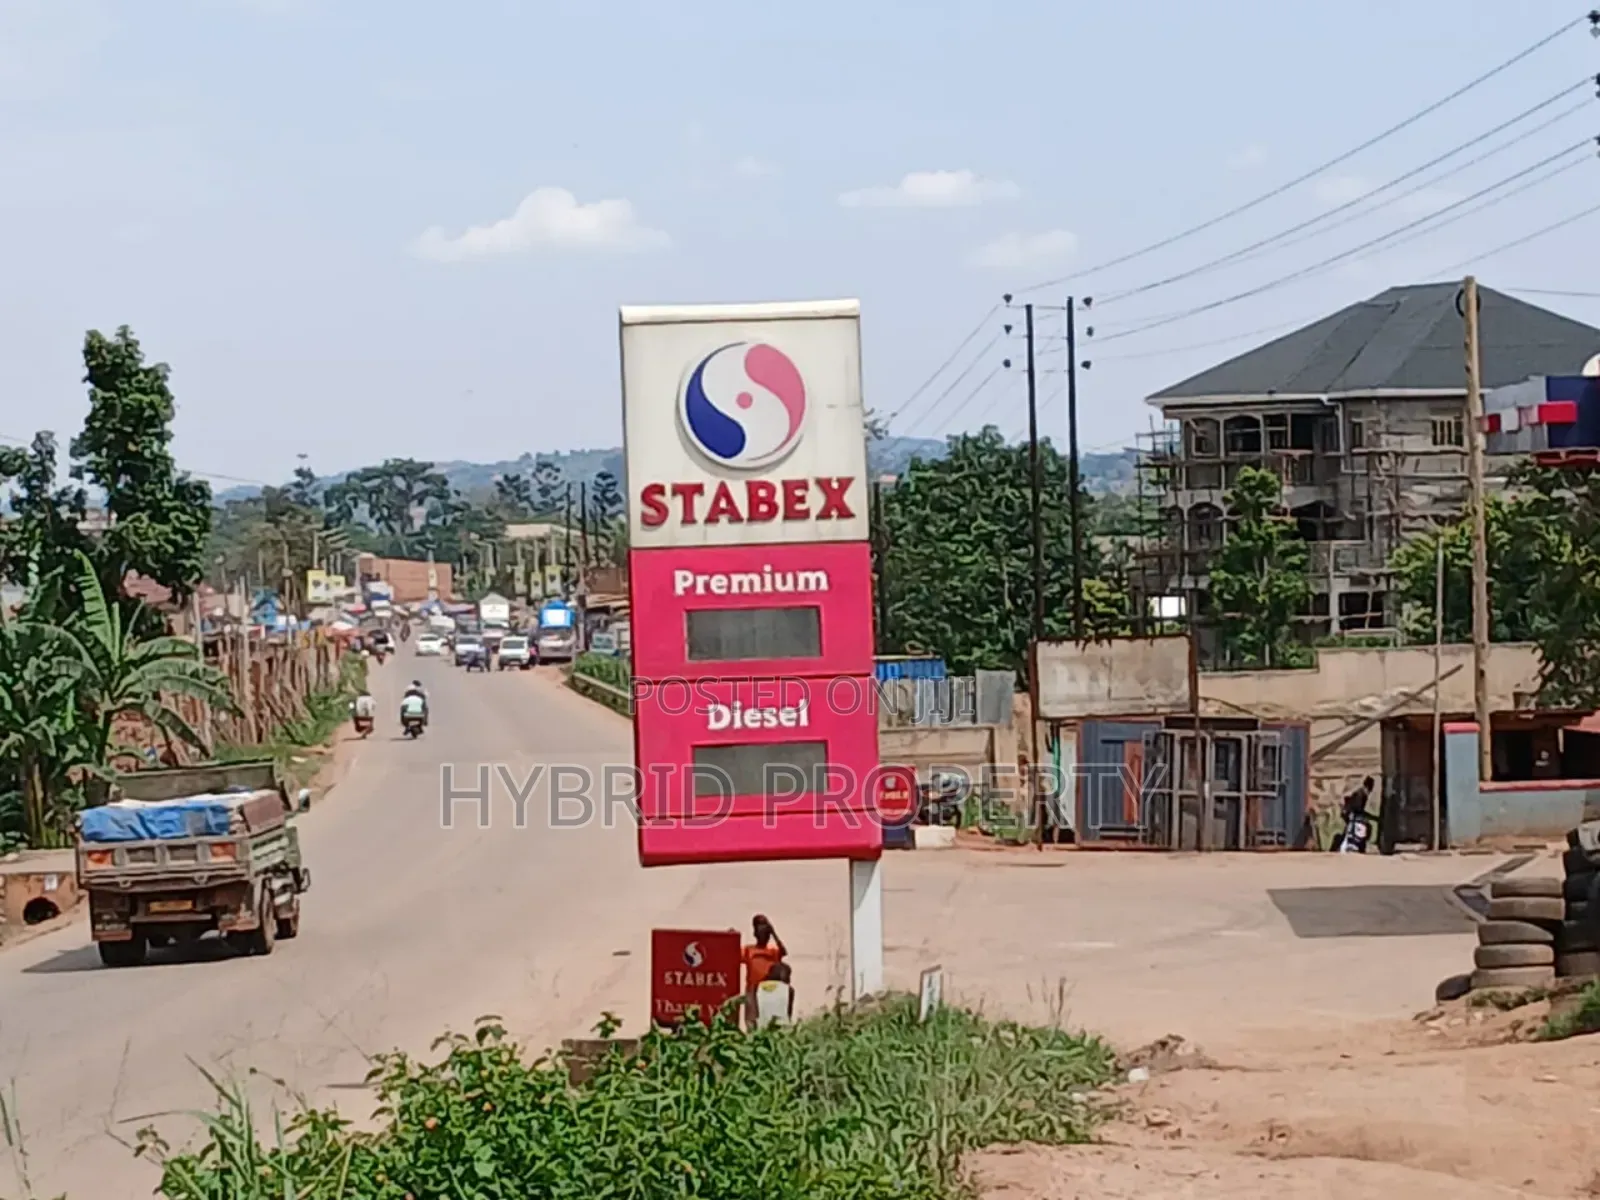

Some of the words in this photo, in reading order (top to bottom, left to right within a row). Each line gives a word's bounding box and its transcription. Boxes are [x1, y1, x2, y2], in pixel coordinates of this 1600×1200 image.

[640, 476, 856, 528] STABEX
[672, 564, 829, 597] Premium
[706, 698, 809, 731] Diesel
[664, 969, 728, 988] STABEX
